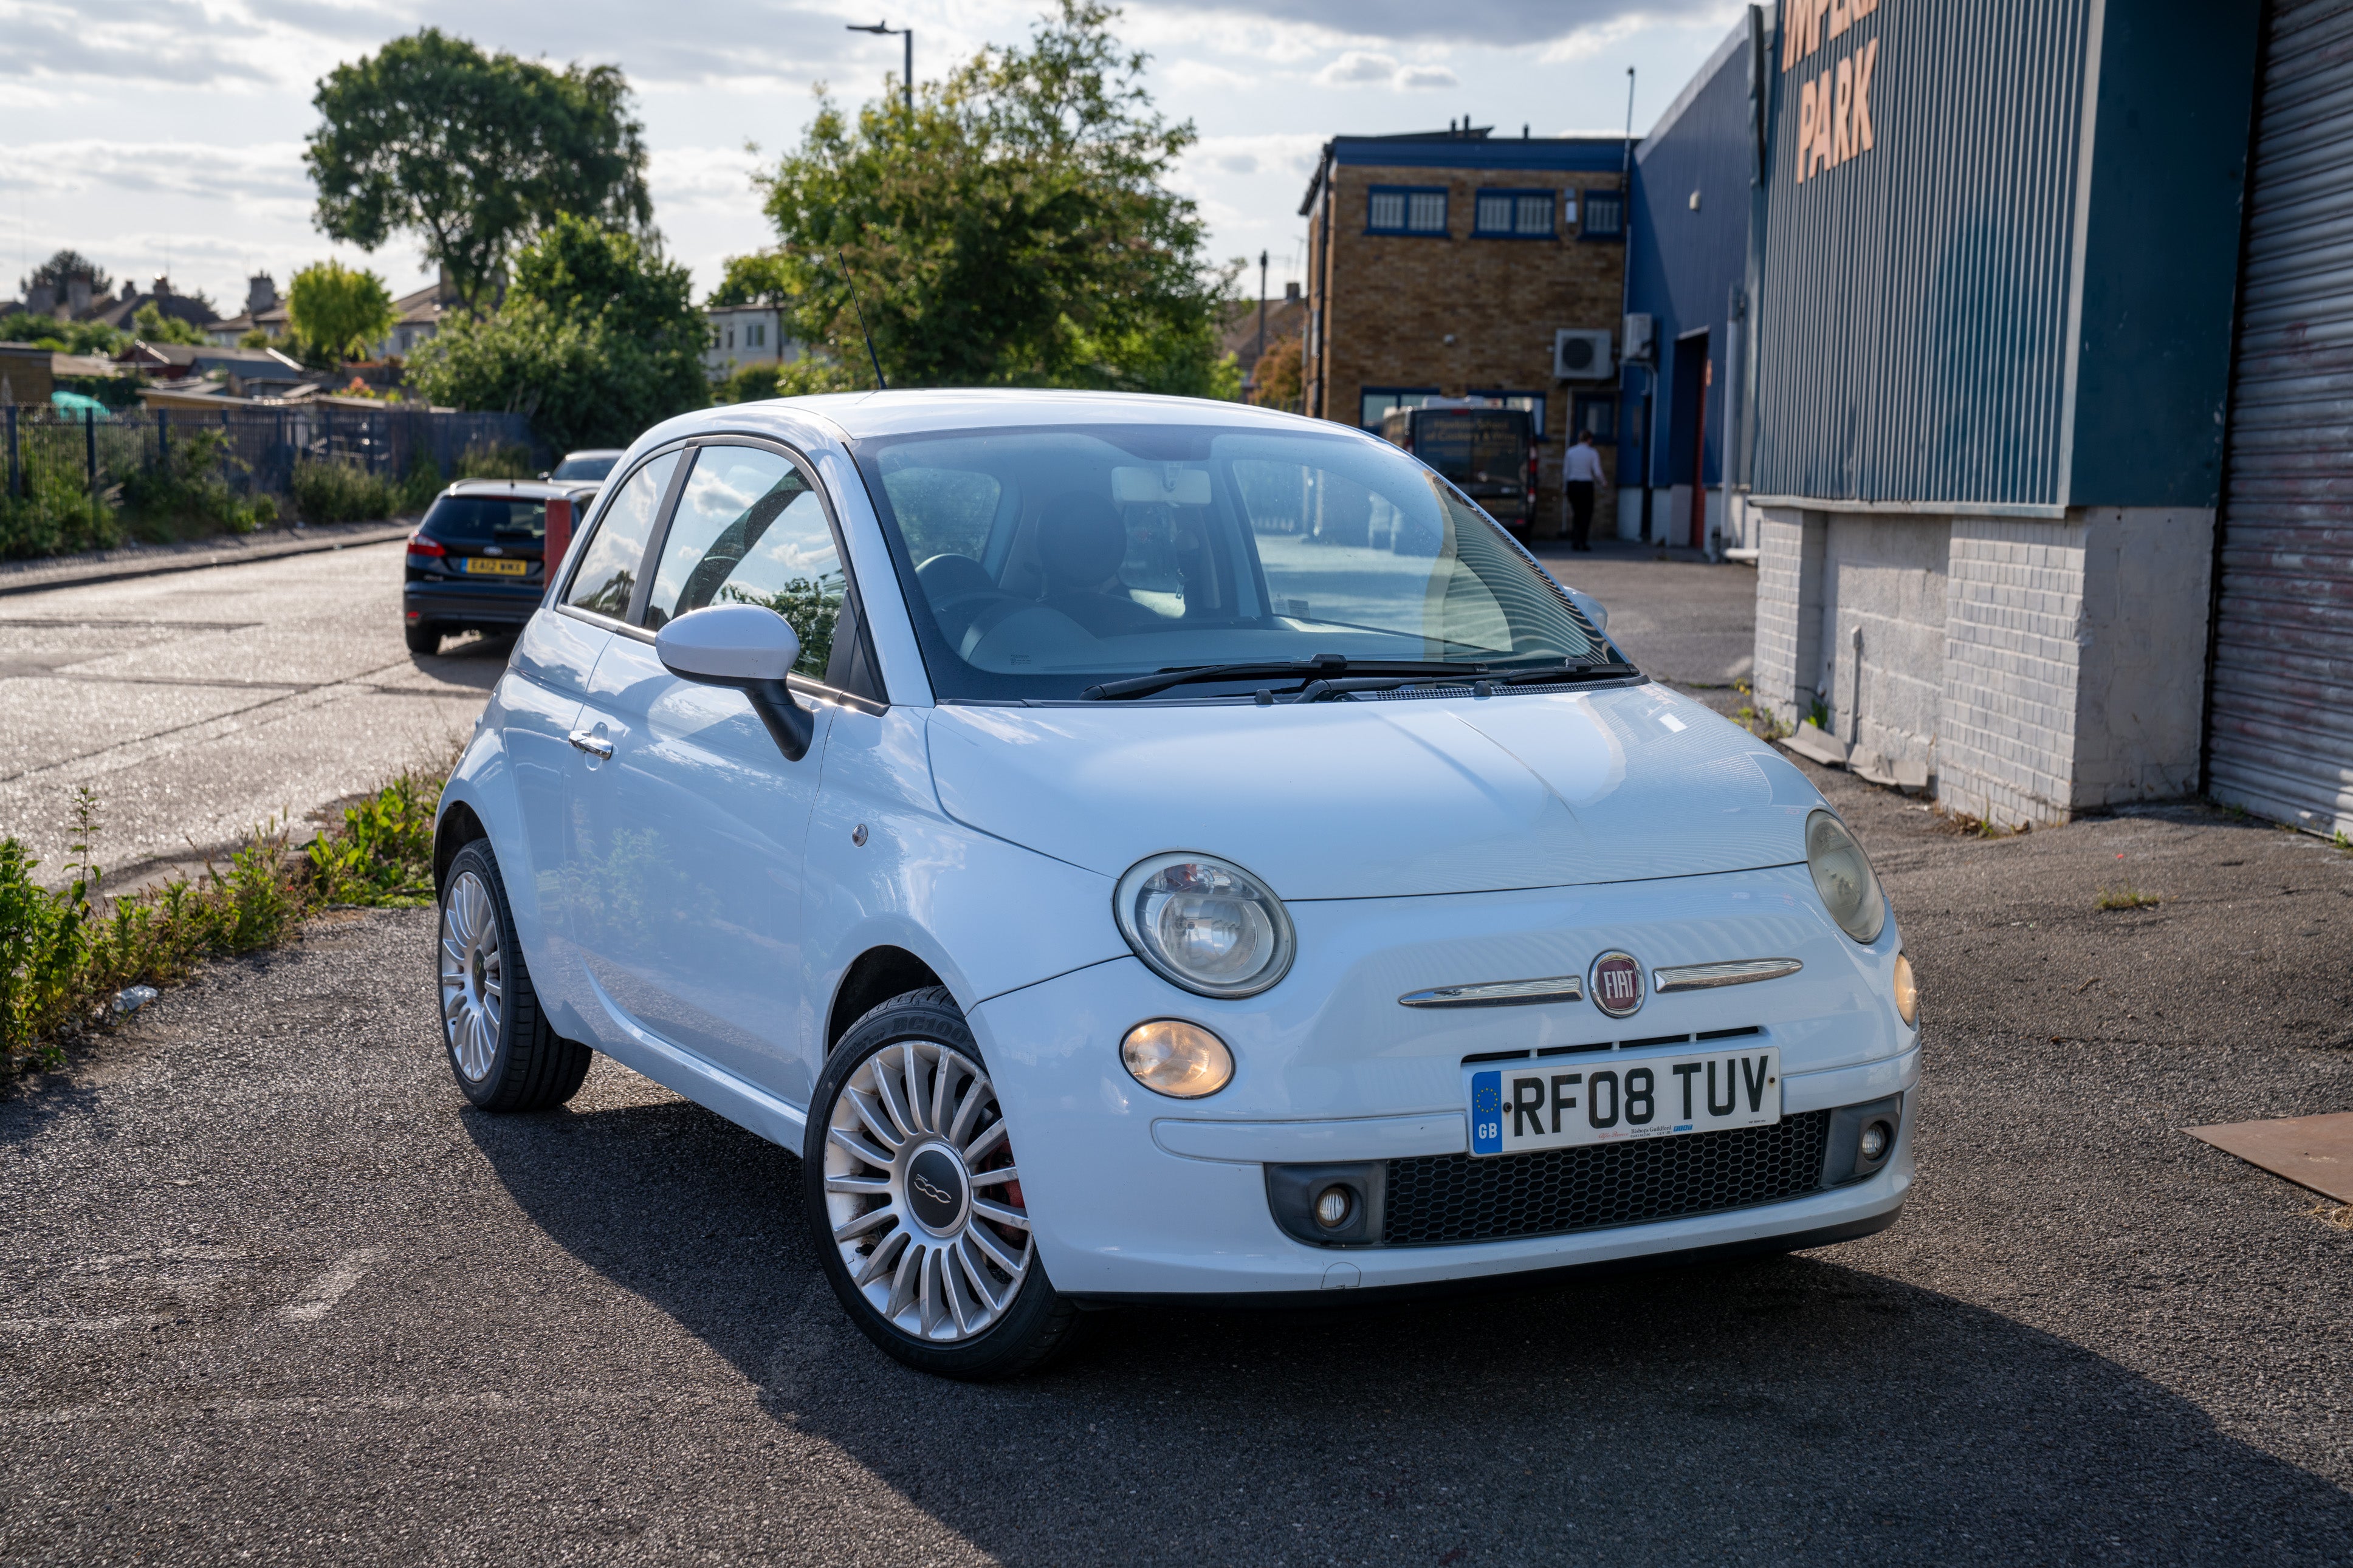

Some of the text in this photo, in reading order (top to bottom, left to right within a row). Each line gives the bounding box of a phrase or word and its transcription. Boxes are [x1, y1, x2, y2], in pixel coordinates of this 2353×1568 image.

[1797, 36, 1878, 185] PARK
[1603, 970, 1633, 999] FIAT
[1513, 1055, 1769, 1137] RF08 TUV
[1479, 1123, 1497, 1139] GB
[1598, 1132, 1610, 1140] Alfa
[1631, 1127, 1649, 1135] Bishops
